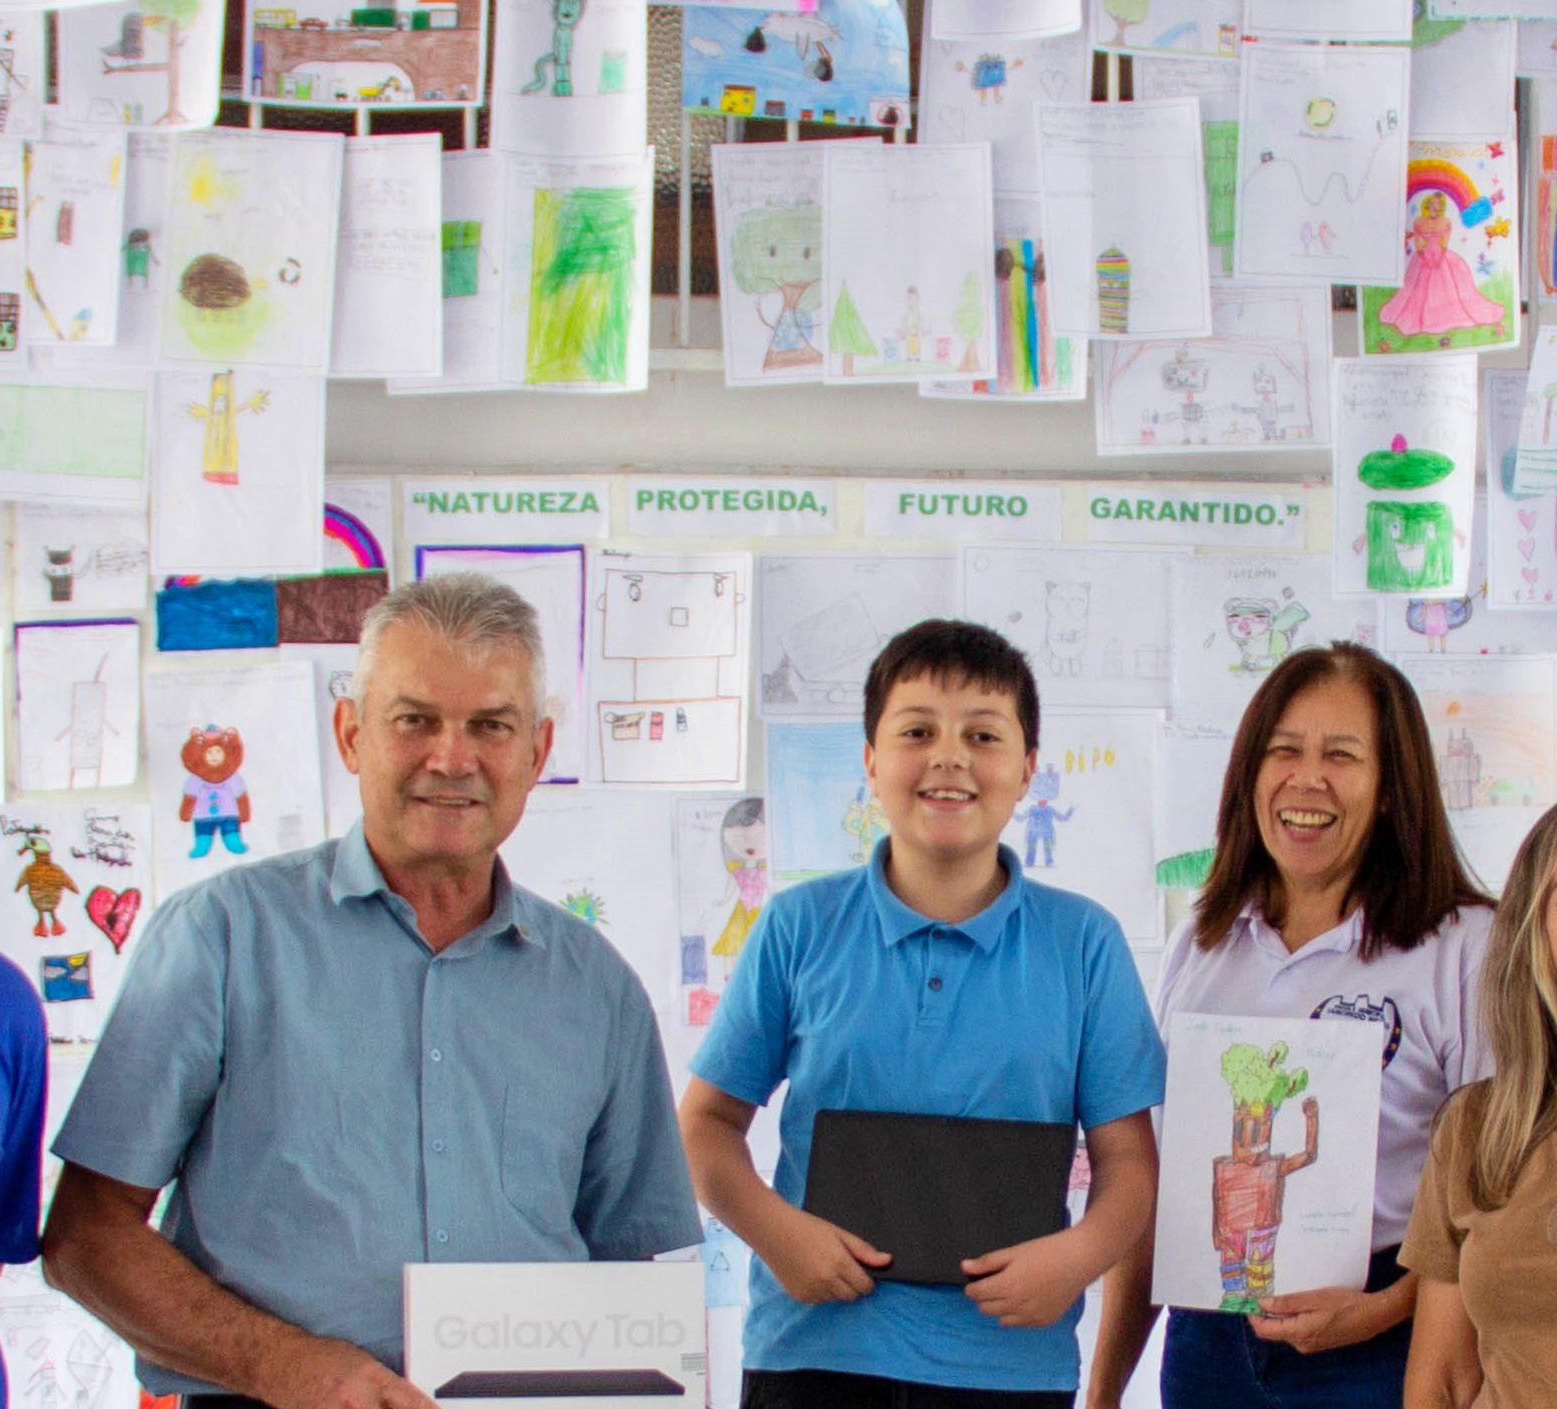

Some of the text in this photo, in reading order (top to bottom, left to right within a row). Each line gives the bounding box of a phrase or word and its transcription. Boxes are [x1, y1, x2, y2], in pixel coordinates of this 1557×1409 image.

[412, 488, 1300, 526] “NATUREZA PROTEGIDA, FUTURO GARANTIDO.”
[434, 1313, 687, 1359] Galaxy Tab
